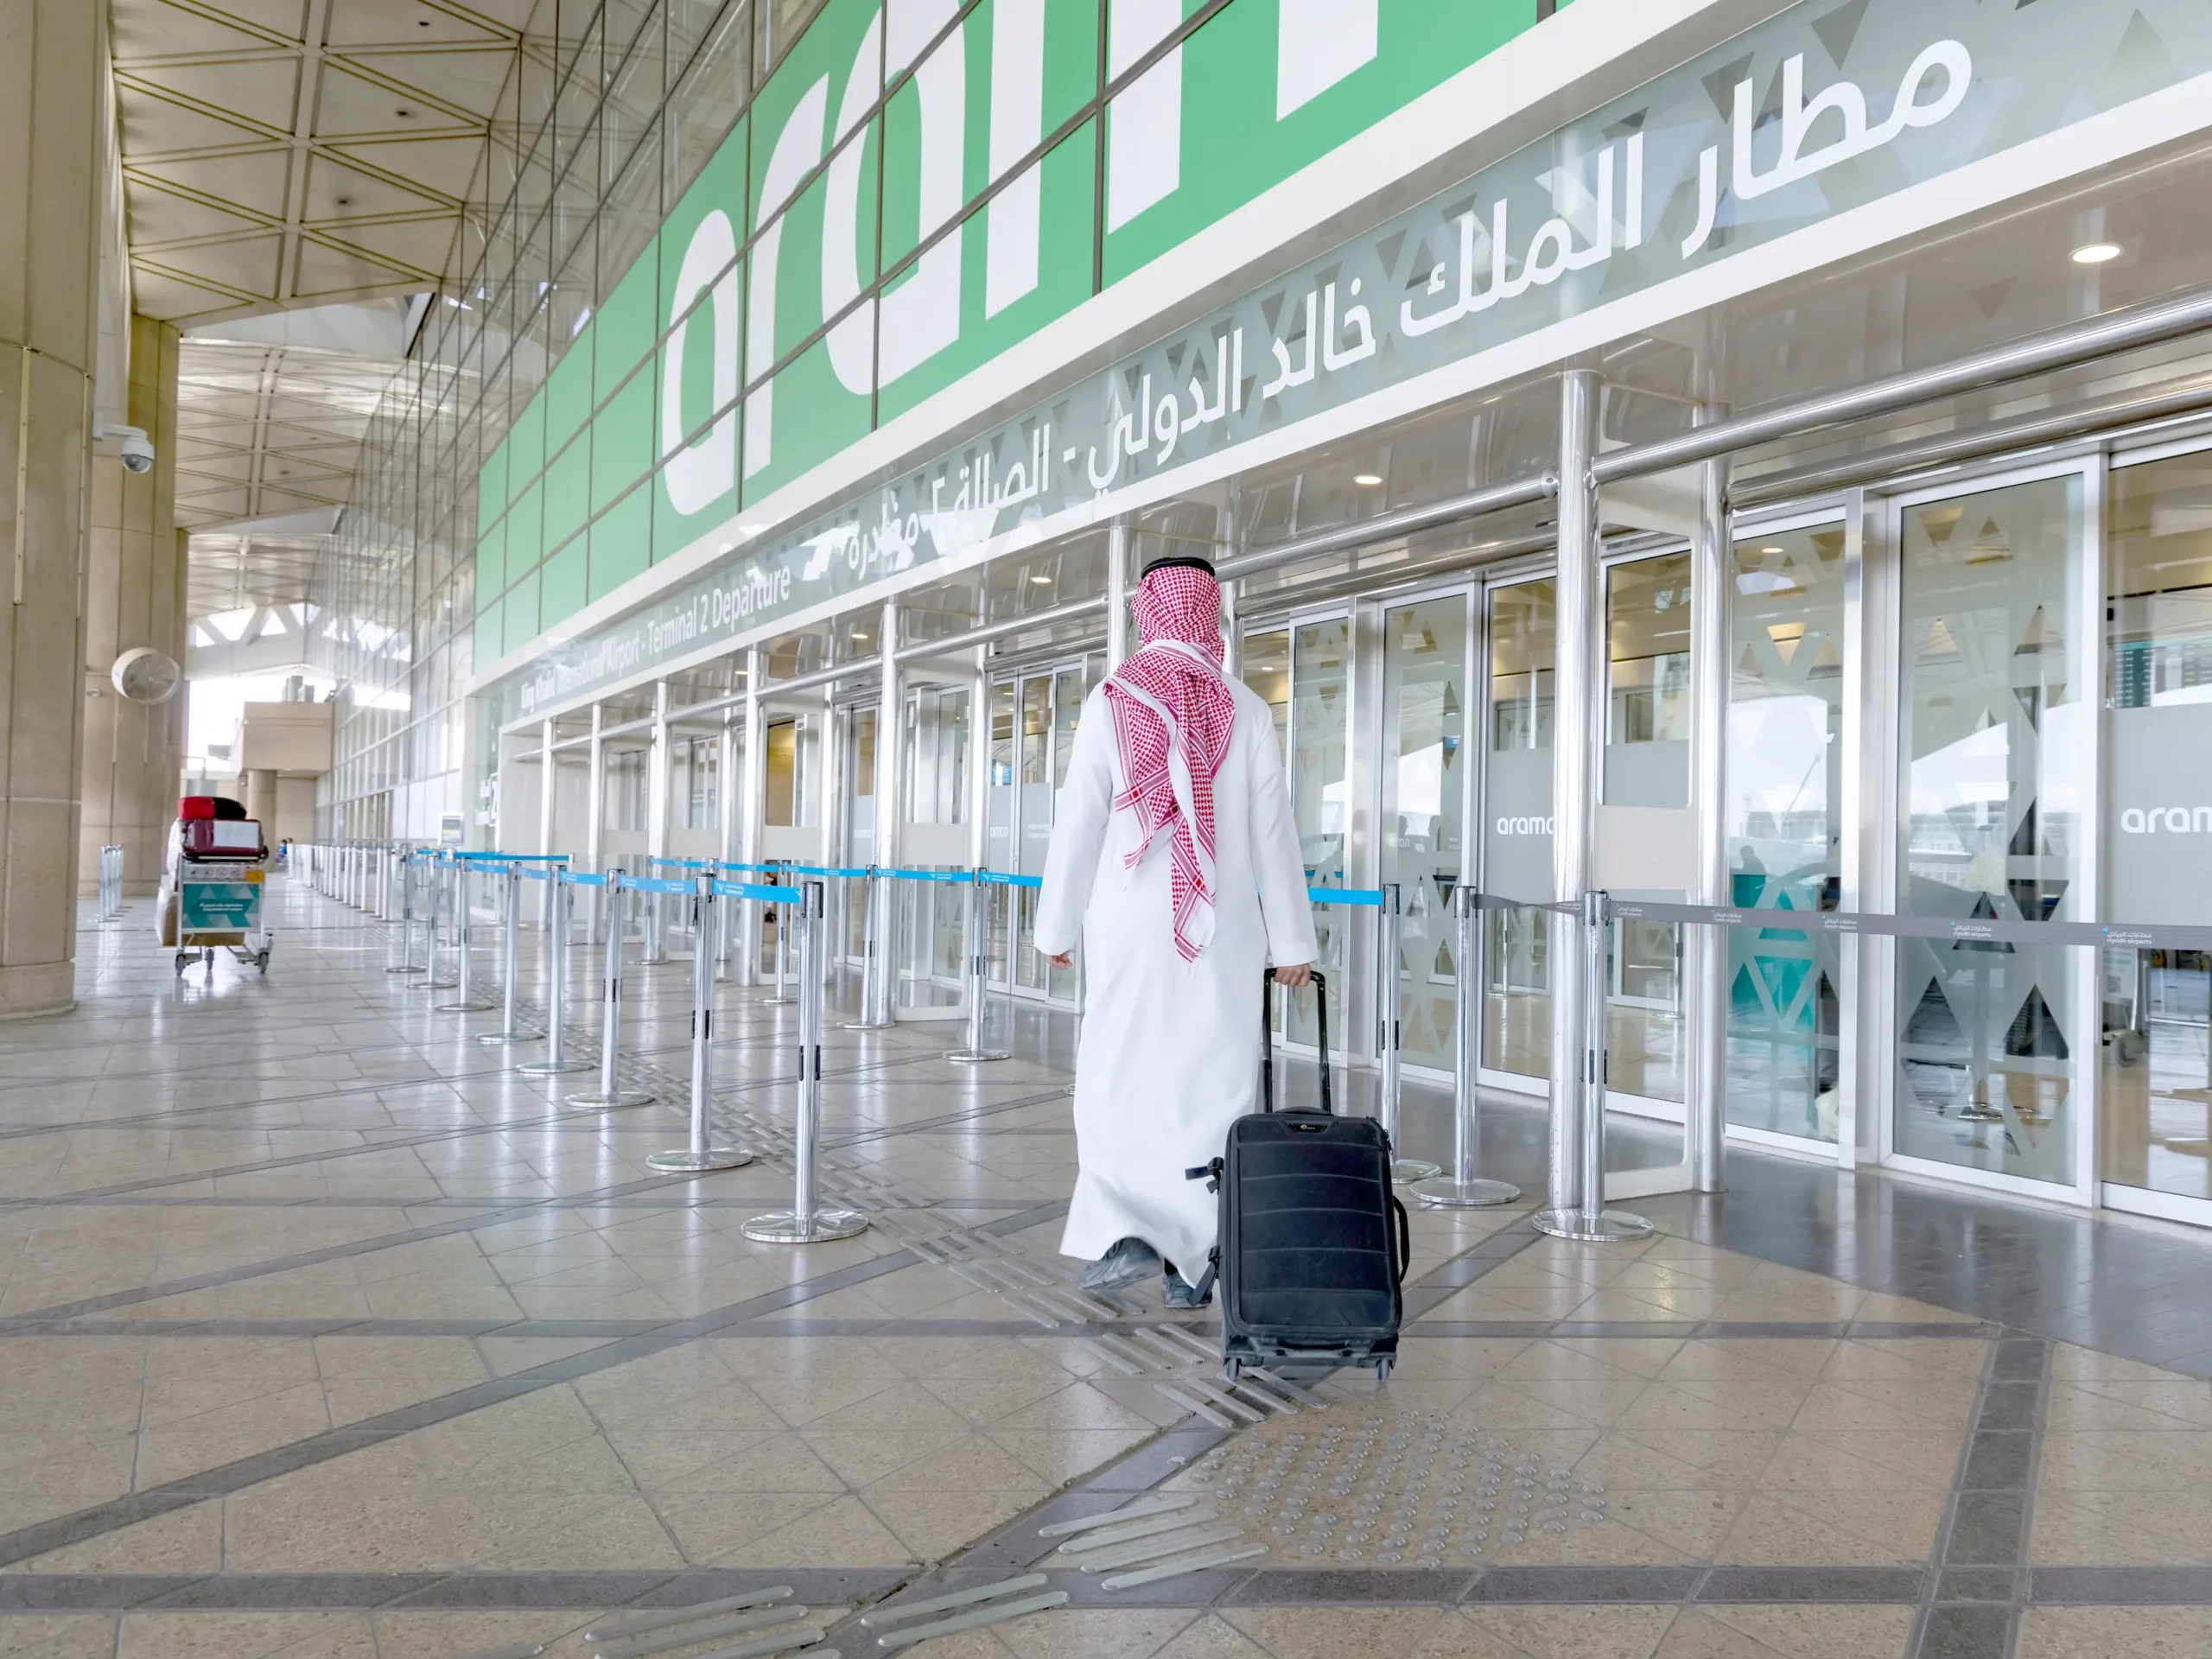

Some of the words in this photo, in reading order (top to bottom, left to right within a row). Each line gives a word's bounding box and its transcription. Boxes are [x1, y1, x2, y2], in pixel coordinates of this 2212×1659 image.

[1681, 39, 1973, 259] مطار
[1400, 130, 1643, 337] الملك
[1262, 277, 1376, 400] خالد
[953, 422, 1051, 517] الصالة
[1087, 327, 1243, 499] الدولي
[647, 595, 697, 656] Terminal
[700, 594, 709, 635] 2
[712, 565, 791, 633] Departure
